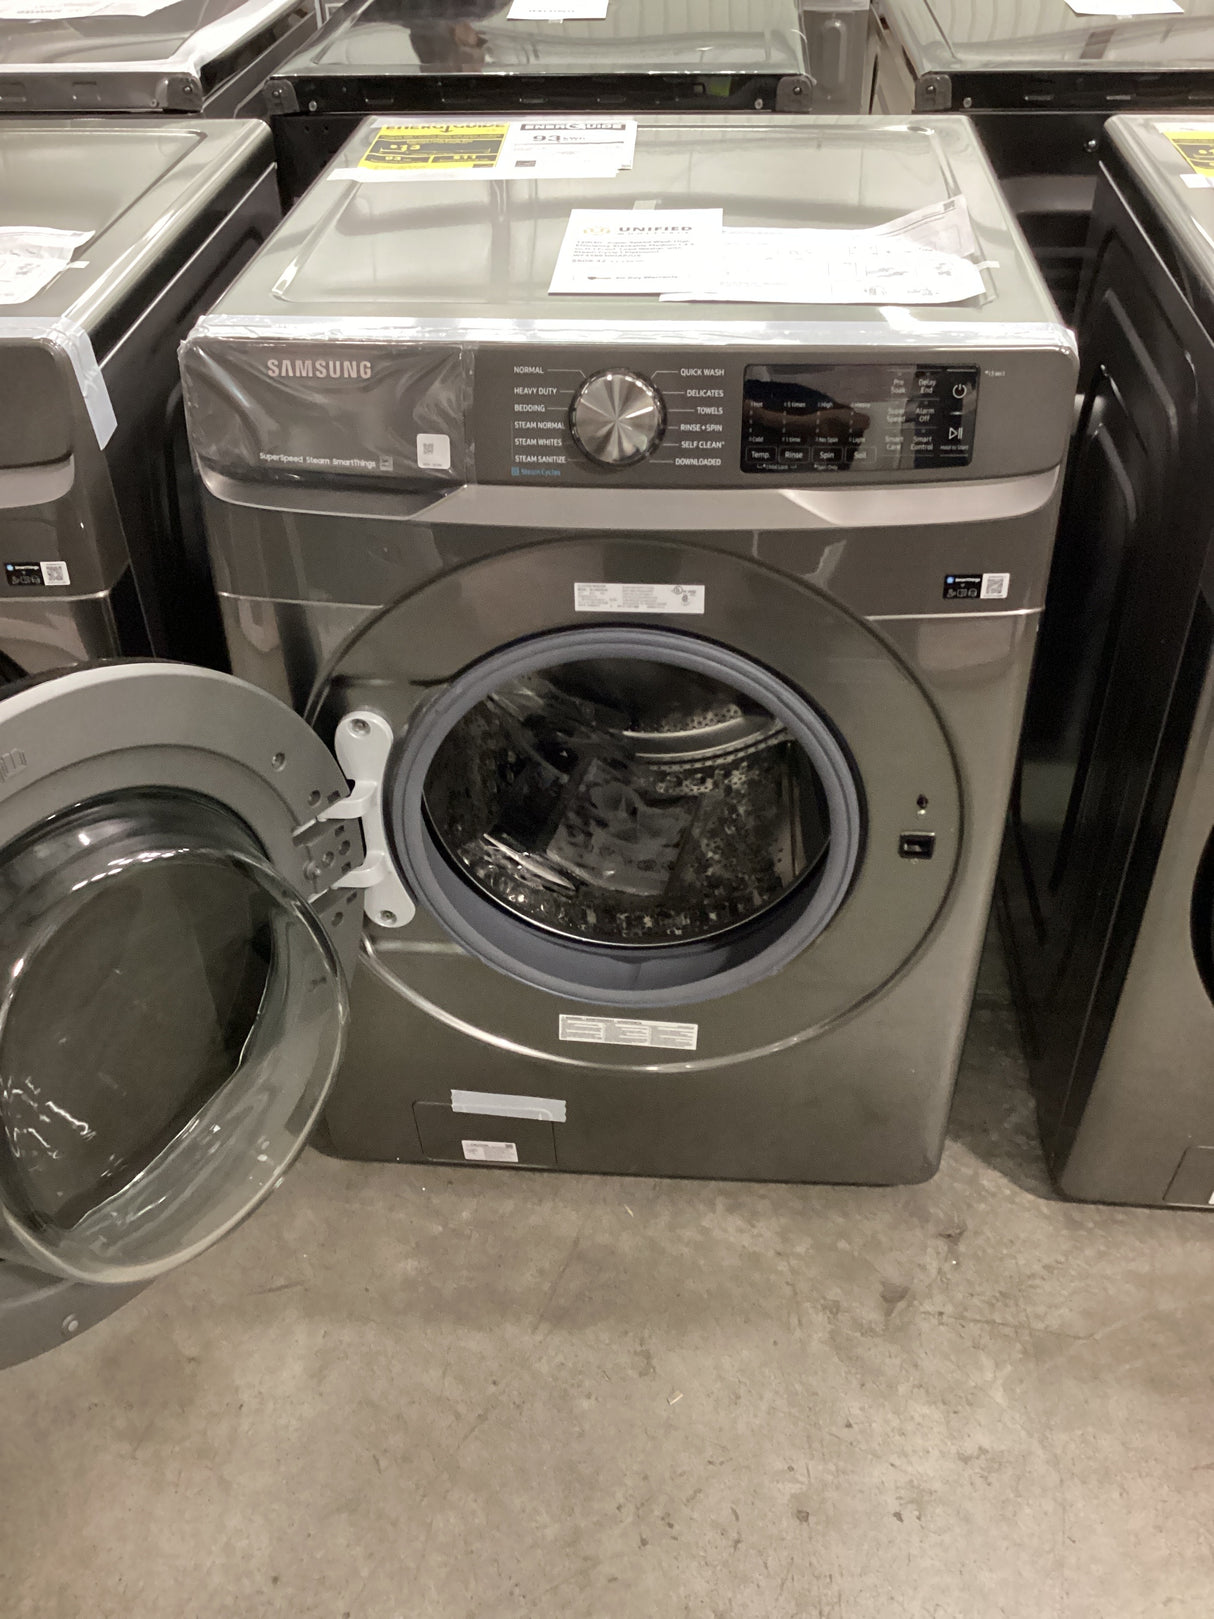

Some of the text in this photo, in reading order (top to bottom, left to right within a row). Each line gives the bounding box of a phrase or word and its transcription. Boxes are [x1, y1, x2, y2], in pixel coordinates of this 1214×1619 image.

[267, 358, 372, 379] SAMSUNG
[513, 366, 544, 374] NORMAL
[680, 368, 725, 376] QUICK WASH
[514, 387, 558, 395] HEAVY DUTY
[686, 389, 724, 397] DELICATES
[514, 404, 546, 412] BEDDING
[697, 407, 723, 415] TOWELS
[514, 421, 565, 430] STEAM NORMAL
[514, 438, 563, 447] STEAM WHITES
[820, 451, 835, 459] Spin
[854, 451, 867, 459] Soil
[259, 452, 304, 464] SuperSpeed
[306, 456, 330, 465] Steam
[333, 458, 377, 469] SmartThings
[515, 455, 567, 464] STEAM SANITIZE
[675, 458, 722, 466] DOWNLOADED
